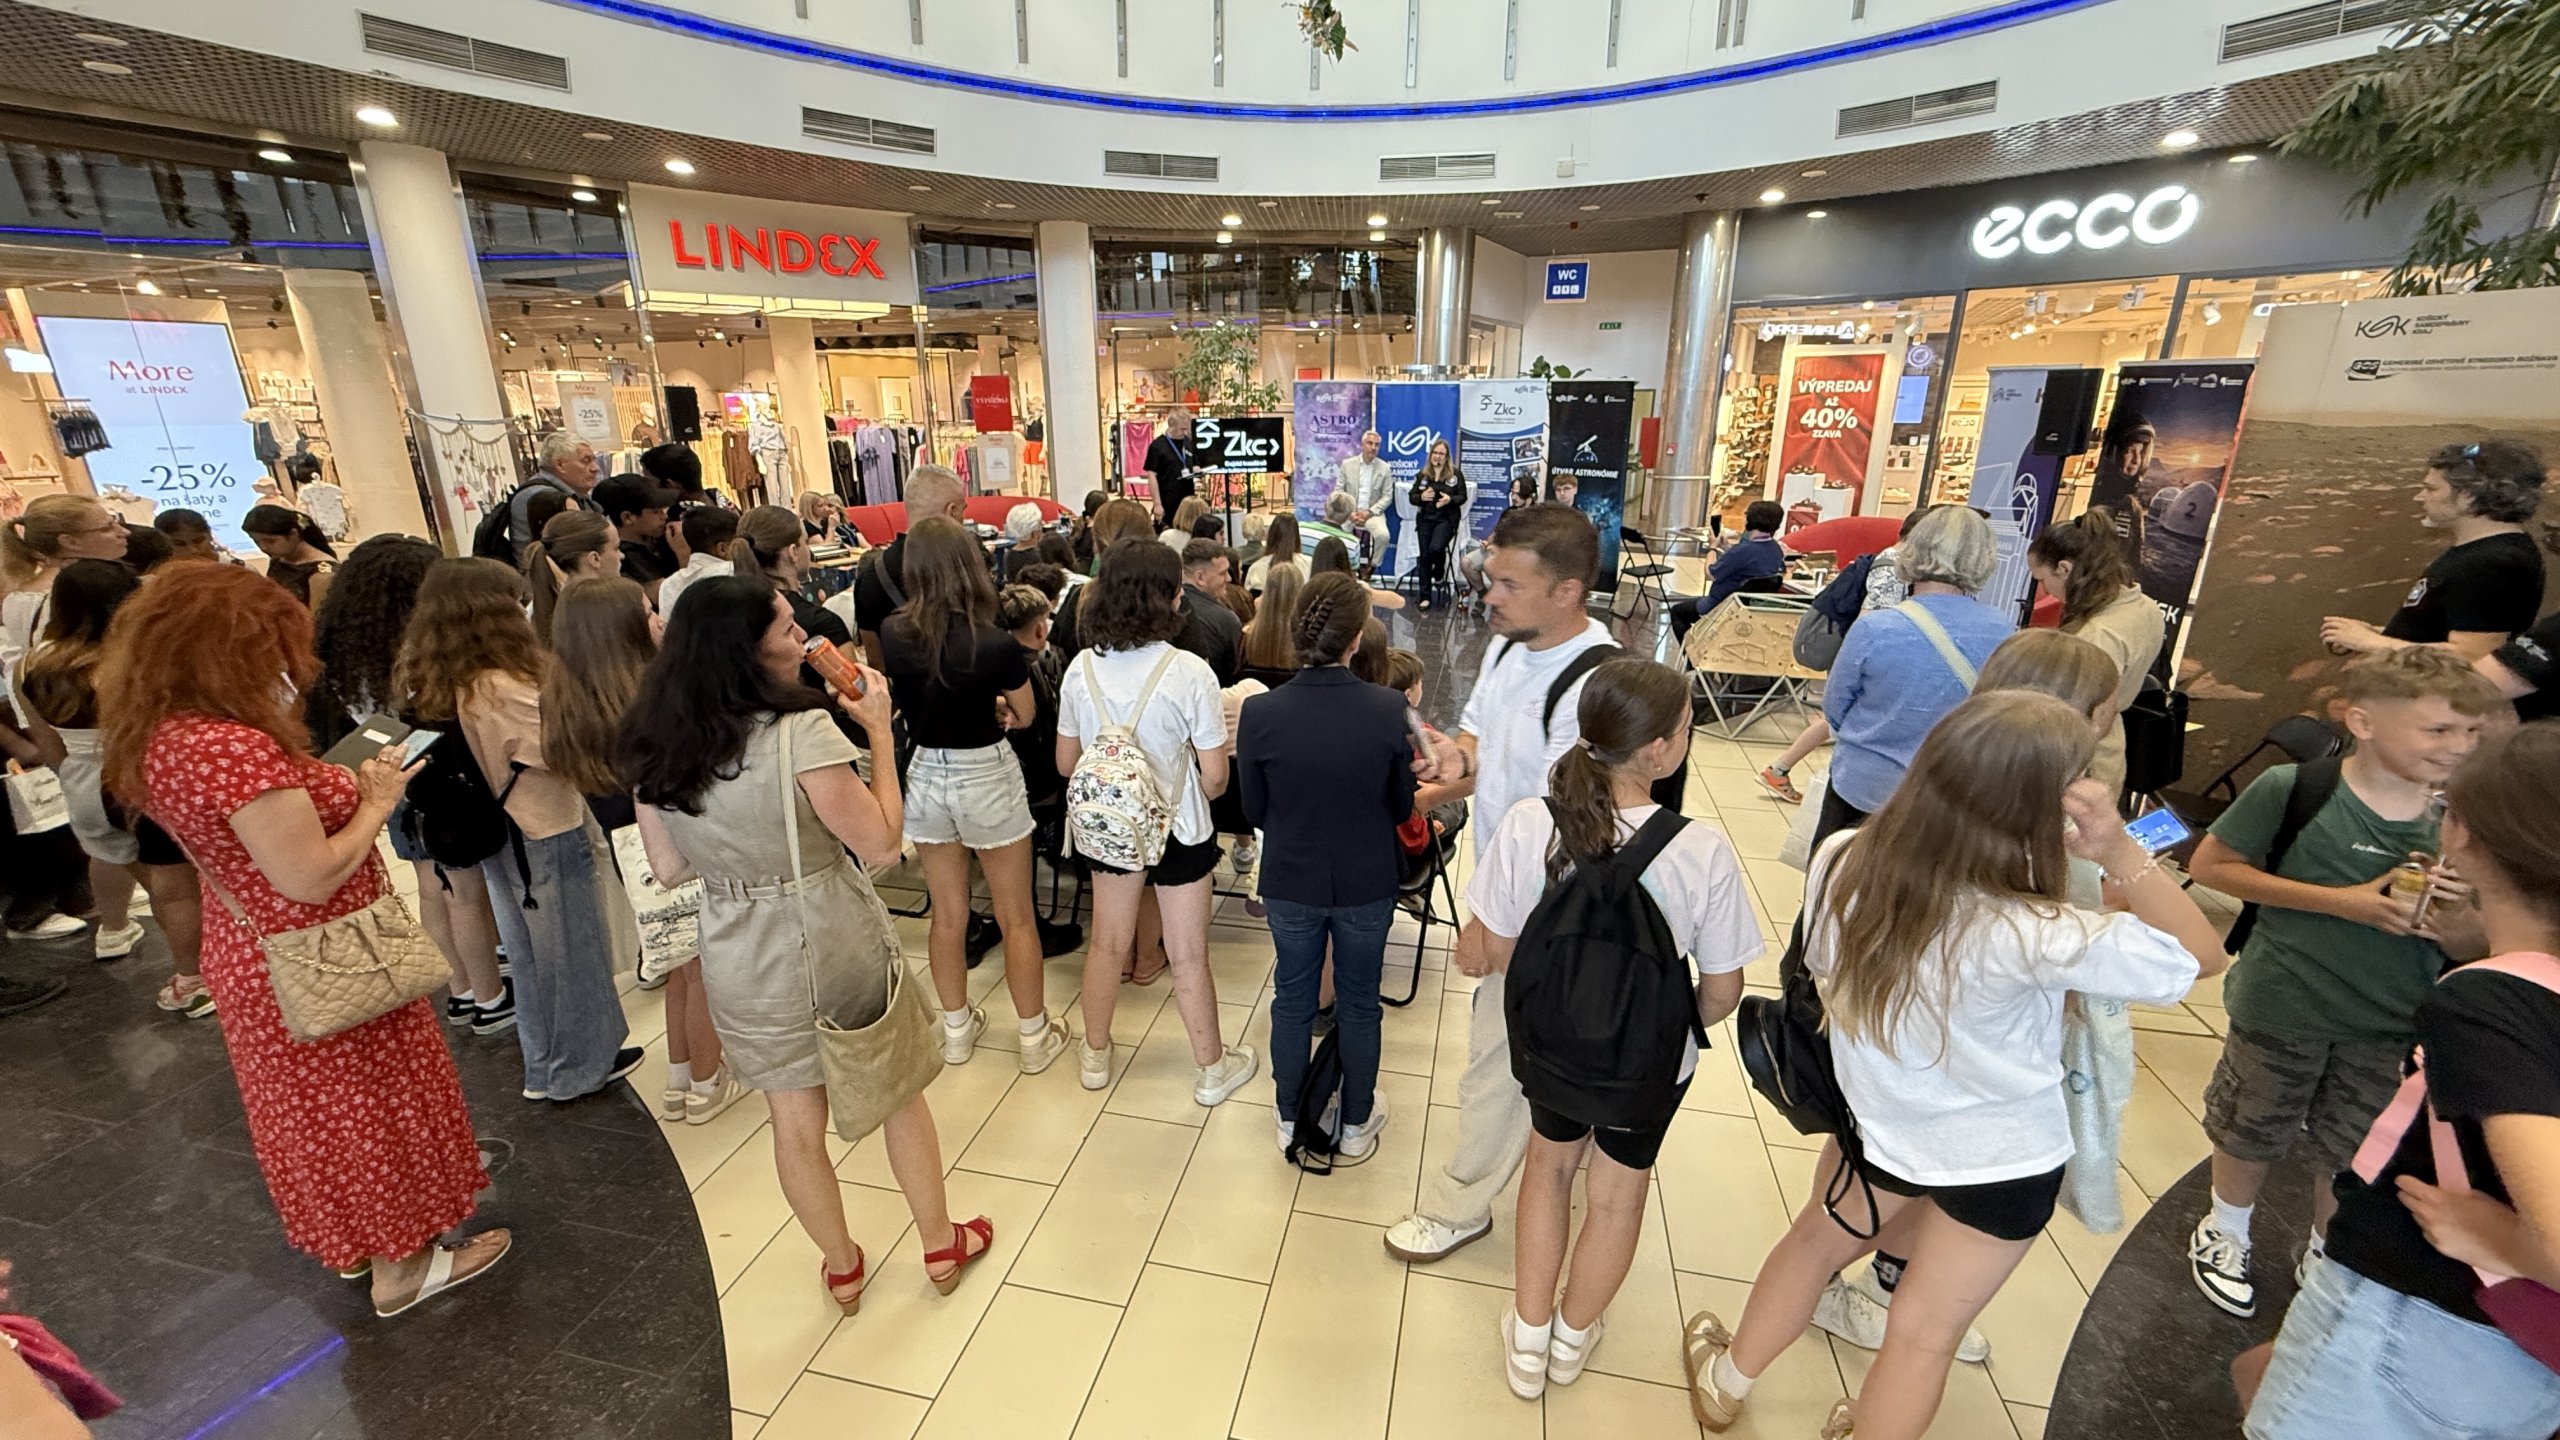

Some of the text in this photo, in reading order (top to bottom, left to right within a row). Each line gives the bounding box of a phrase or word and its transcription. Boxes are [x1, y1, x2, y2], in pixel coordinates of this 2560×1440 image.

[1972, 185, 2199, 260] ecco
[669, 219, 885, 279] LINDEX
[1558, 269, 1577, 281] WC
[2355, 315, 2411, 339] KSK
[109, 360, 195, 381] More
[141, 386, 188, 394] LINDEX
[1798, 378, 1873, 393] VÝPREDAJ
[1825, 396, 1839, 406] AŽ
[1311, 415, 1356, 425] ASTRO
[1800, 408, 1858, 428] 40%
[1812, 429, 1842, 438] ZĽAVA
[141, 463, 236, 491] -25%
[1575, 468, 1619, 478] ASTRONÓMIE
[161, 498, 180, 507] na
[219, 495, 227, 503] a
